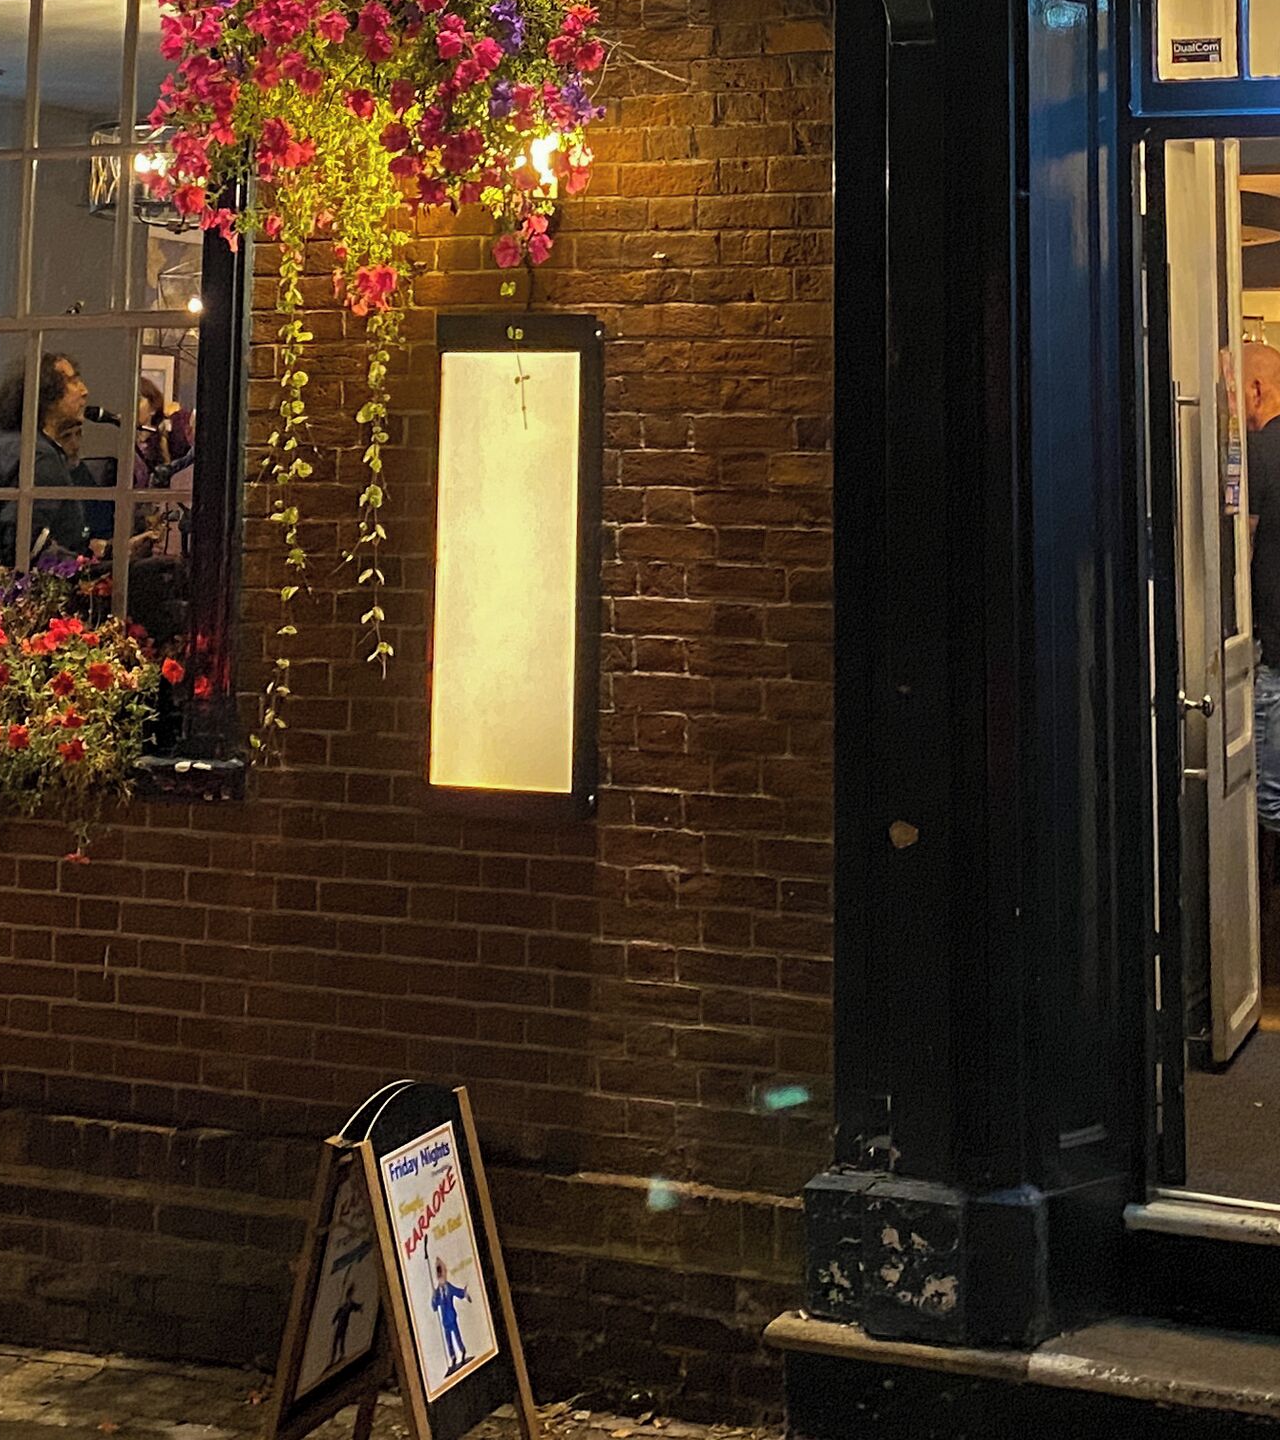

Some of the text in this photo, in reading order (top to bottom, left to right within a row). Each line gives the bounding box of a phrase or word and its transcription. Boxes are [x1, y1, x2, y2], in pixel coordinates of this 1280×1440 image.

[1173, 42, 1219, 53] DualCom
[388, 1155, 419, 1182] Friday
[420, 1141, 451, 1168] Nights
[404, 1165, 457, 1260] KARAOKE
